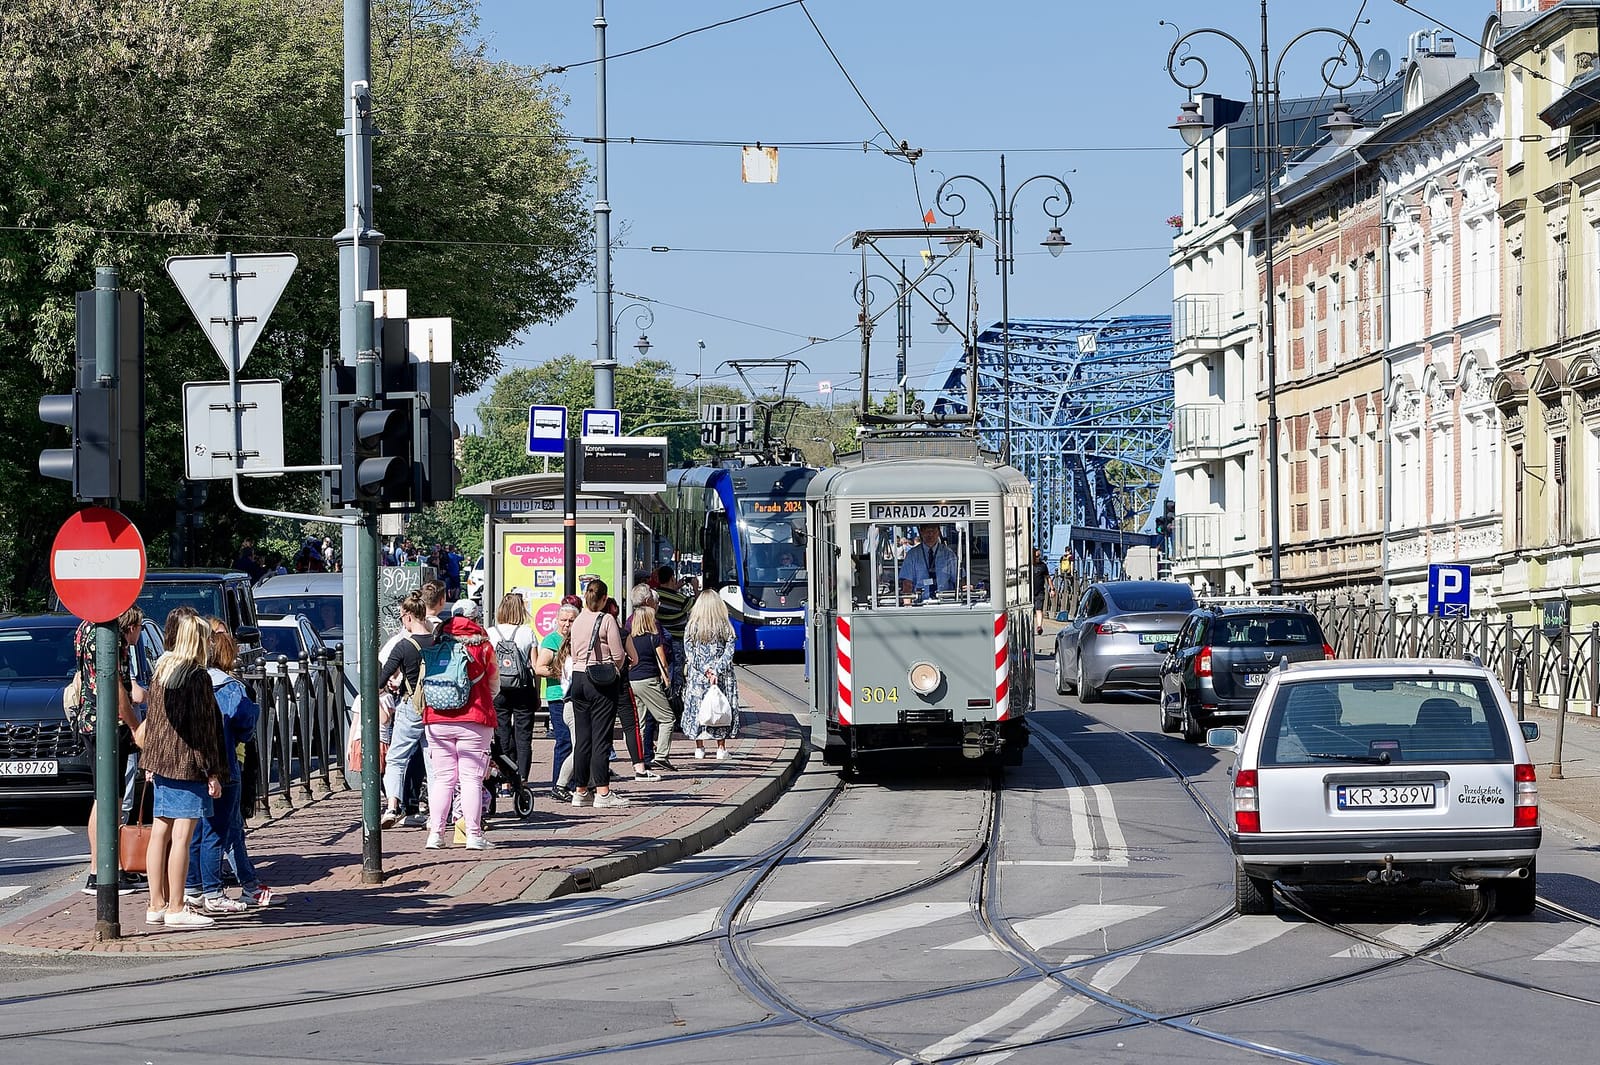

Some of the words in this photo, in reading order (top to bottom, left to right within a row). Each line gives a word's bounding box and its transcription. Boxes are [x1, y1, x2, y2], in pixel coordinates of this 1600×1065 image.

[534, 501, 541, 509] 72
[754, 502, 781, 512] Parada
[784, 501, 802, 512] 2024
[877, 505, 926, 518] PARADA
[932, 505, 965, 518] 2024
[537, 545, 562, 554] rabaty
[539, 555, 562, 564] Żabka
[1438, 569, 1462, 602] P
[861, 686, 899, 703] 304
[17, 762, 54, 773] 89769
[1349, 788, 1372, 804] KR
[1380, 787, 1430, 804] 3369V
[1464, 785, 1502, 795] Przedszkole
[1458, 793, 1505, 804] Guzikowo
